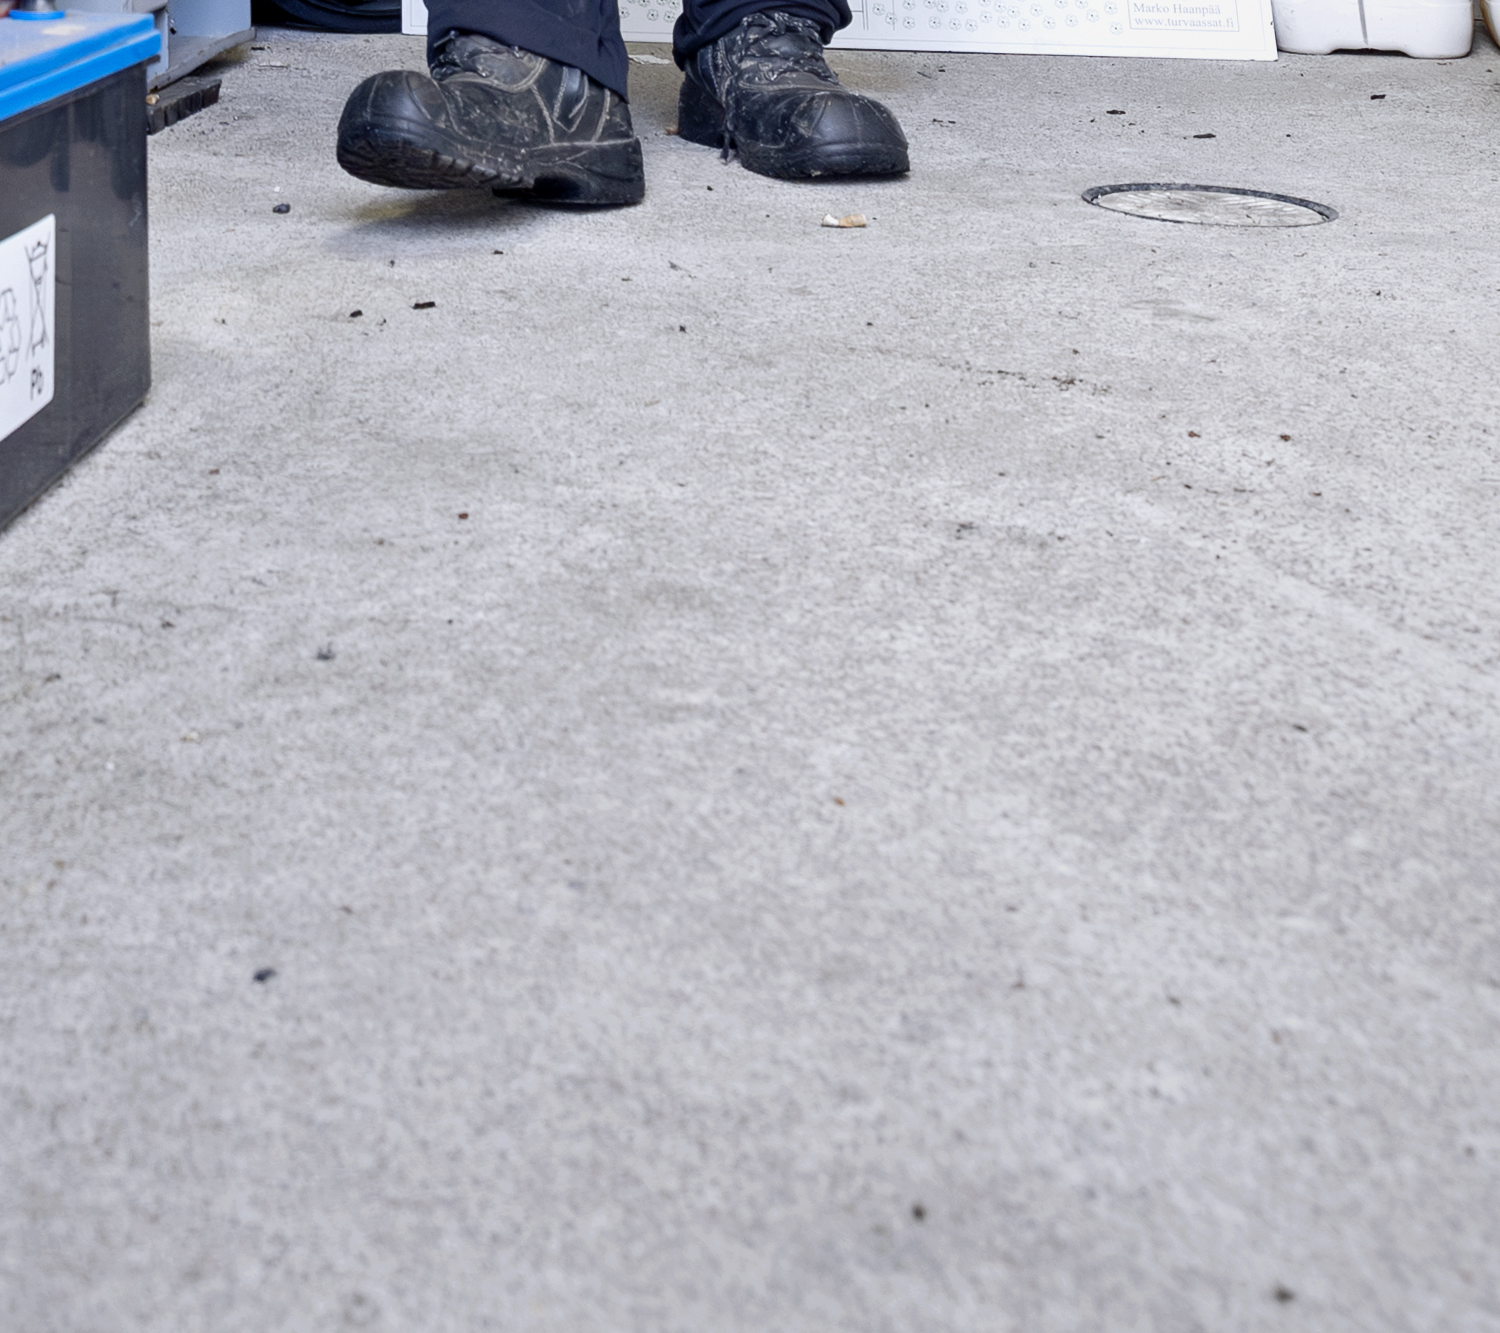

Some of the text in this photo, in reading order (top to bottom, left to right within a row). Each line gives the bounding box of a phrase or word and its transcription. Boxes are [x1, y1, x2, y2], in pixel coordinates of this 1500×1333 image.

[1133, 3, 1221, 16] Marko Haanpää
[1134, 17, 1234, 28] www.turvaassat.fi
[30, 365, 44, 401] Pb
